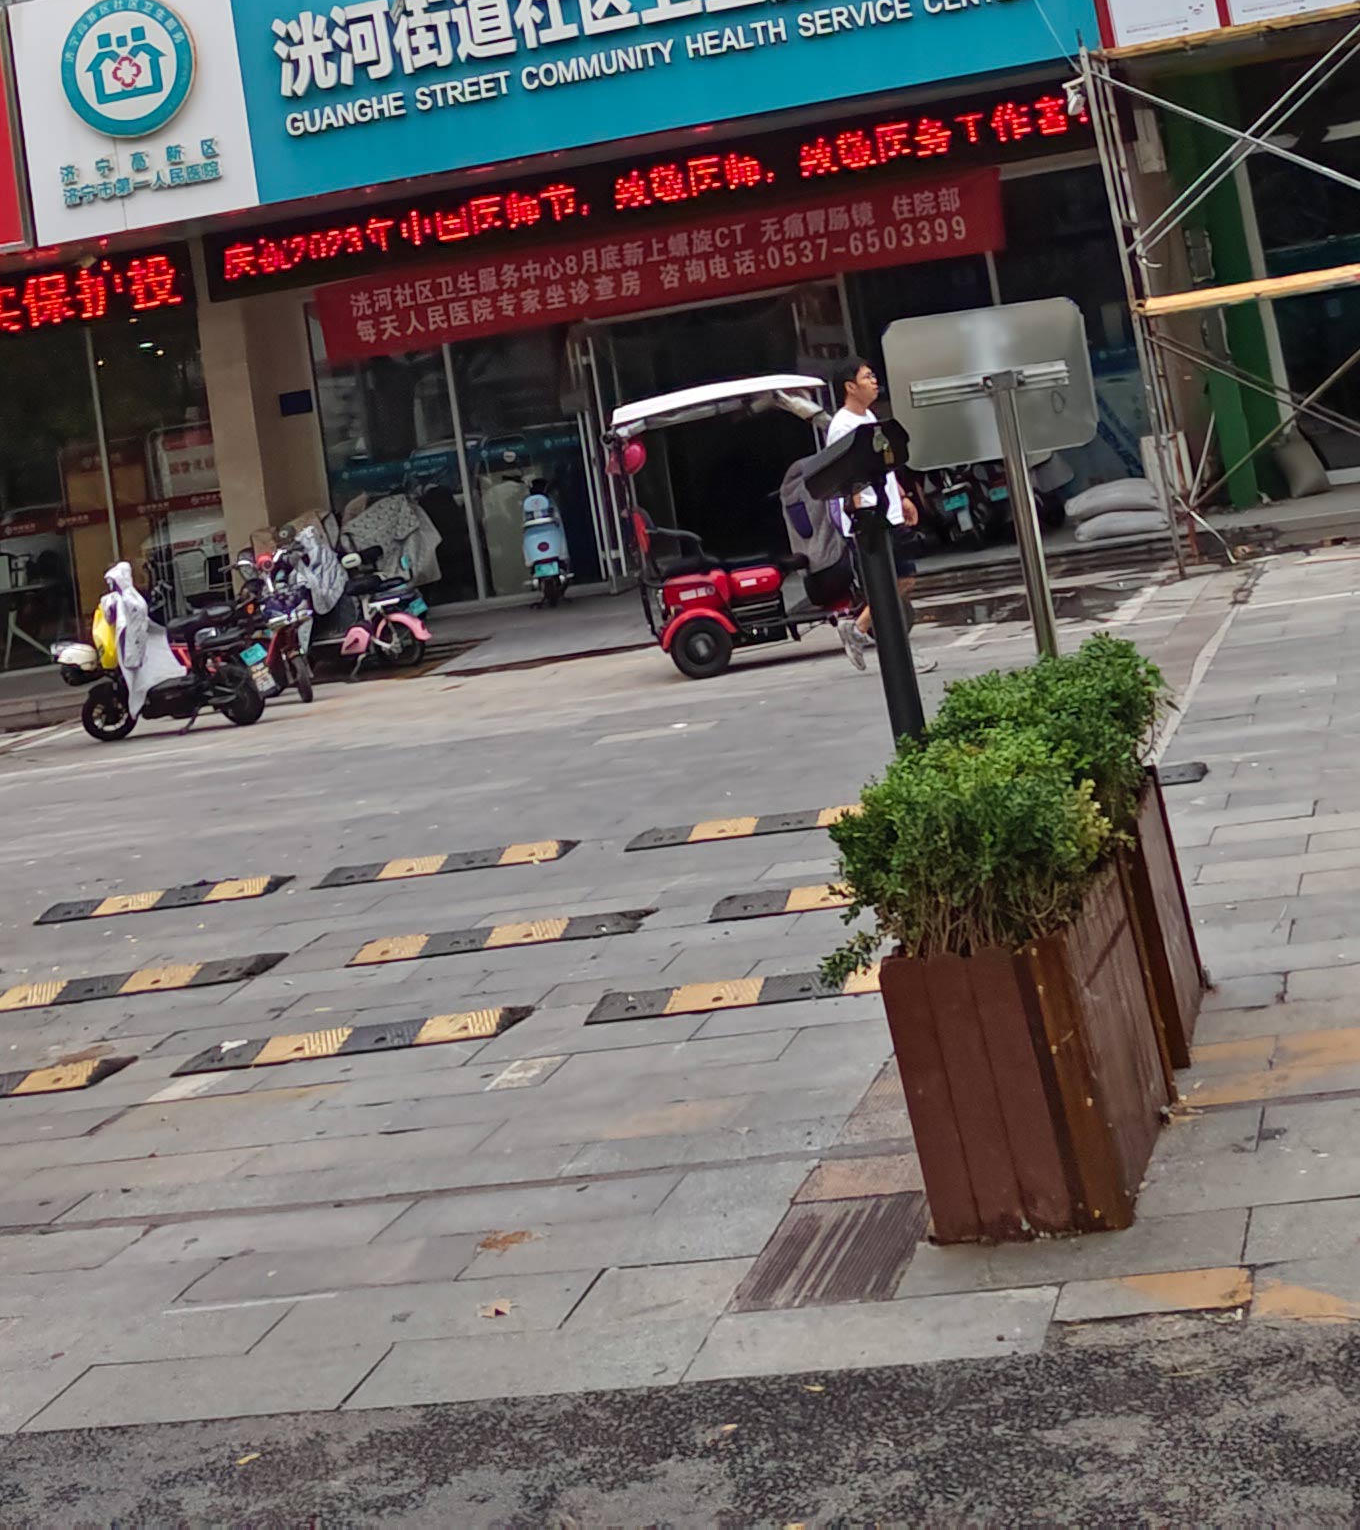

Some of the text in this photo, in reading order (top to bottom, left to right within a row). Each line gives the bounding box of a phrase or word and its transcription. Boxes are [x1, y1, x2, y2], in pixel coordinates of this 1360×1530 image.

[285, 92, 407, 137] GUANGHE
[415, 71, 511, 112] STREET
[521, 39, 675, 91] COMMUNITY
[686, 18, 787, 58] HEALTH
[60, 138, 220, 185] 济宁高新区
[63, 161, 222, 208] 济宁市第一人民医院
[350, 187, 960, 318] 洸河社区卫生服务中心8月底新上螺旋CT 无痛胃肠镜 住院部
[356, 269, 641, 344] 每天人民医院专家坐诊查房
